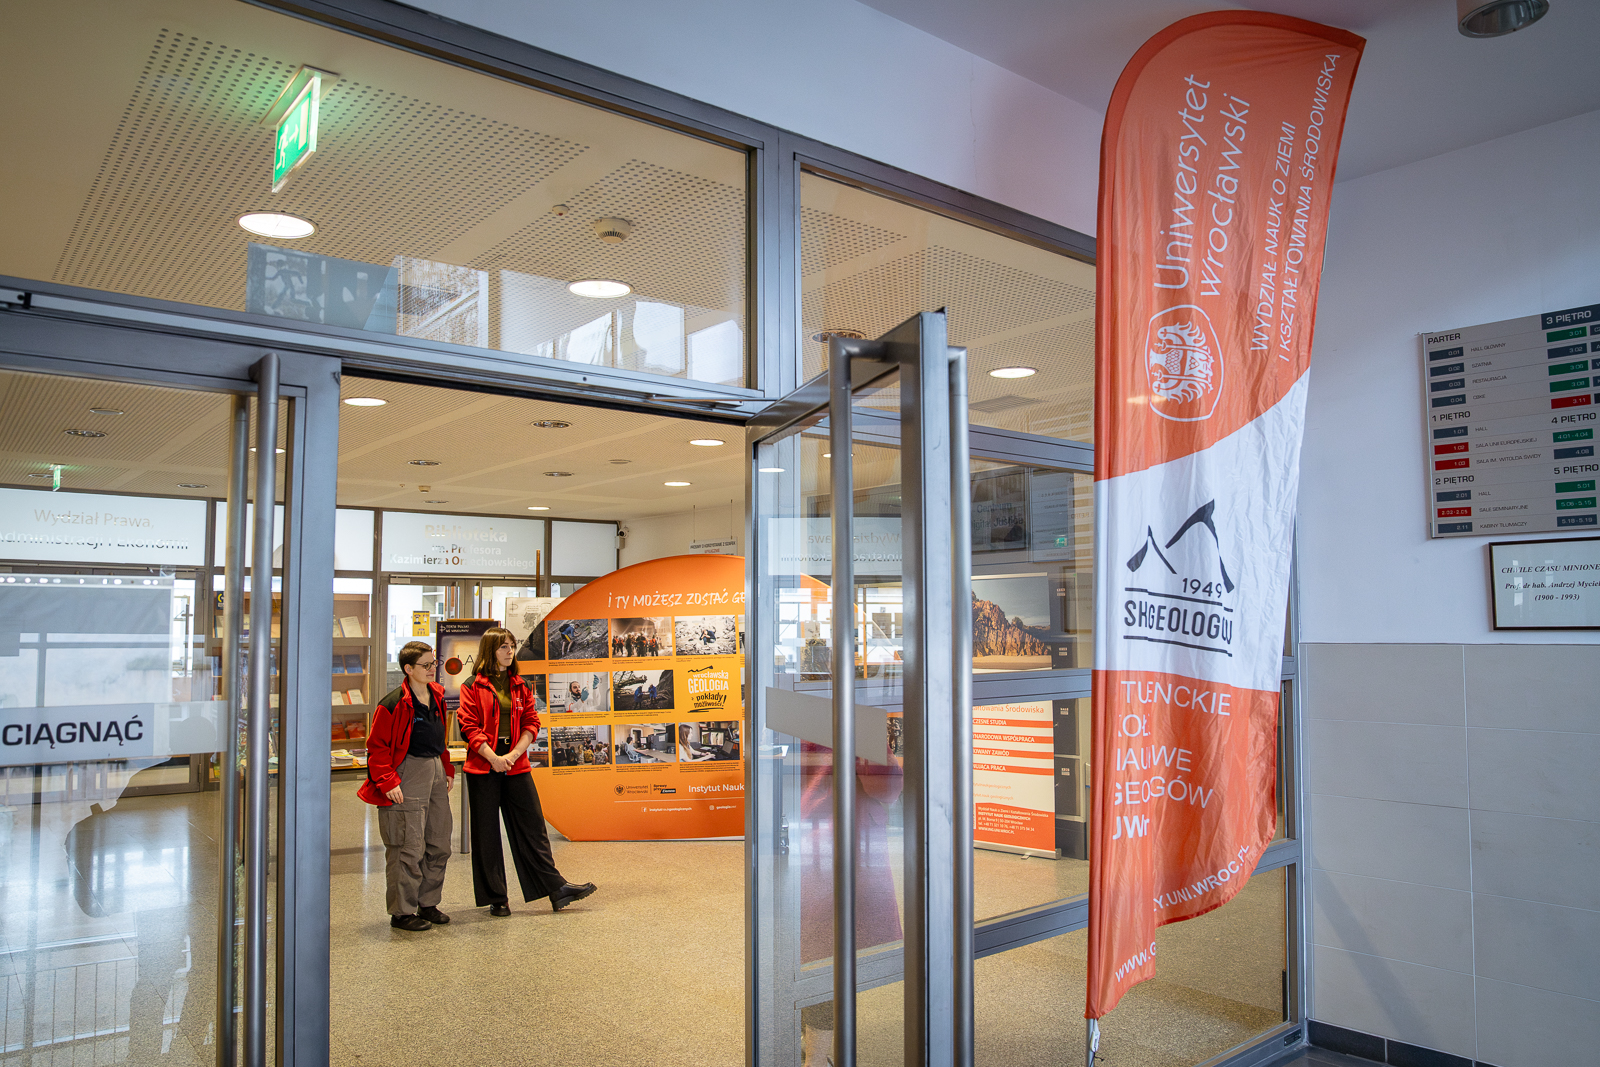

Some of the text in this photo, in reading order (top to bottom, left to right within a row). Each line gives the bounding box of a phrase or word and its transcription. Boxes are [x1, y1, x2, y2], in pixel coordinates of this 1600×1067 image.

[1154, 74, 1211, 289] Uniwersytet
[1201, 92, 1250, 296] Wrocławski
[1280, 184, 1313, 348] KSZTAŁTOWANIA
[1298, 53, 1341, 181] ŚRODOWISKA
[1250, 121, 1296, 351] WYDZIAŁ NAUK O ZIEMI
[1556, 310, 1592, 323] PIĘTRO
[1428, 332, 1461, 344] PARTER
[1440, 410, 1470, 421] PIĘTRO
[1560, 412, 1596, 424] PIĘTRO
[1563, 464, 1599, 474] PIĘTRO
[1444, 475, 1475, 485] PIĘTRO
[34, 509, 99, 526] Wydział
[425, 524, 508, 542] Biblioteka
[390, 554, 449, 566] Kazimierza
[1182, 578, 1222, 598] 1949
[615, 595, 630, 609] TY
[633, 590, 682, 607] MOŻESZ
[686, 588, 728, 606] ZOSTAĆ
[688, 678, 729, 694] GEOLOGIA
[1006, 704, 1044, 713] Środowiska
[2, 714, 143, 749] CIĄGNĄĆ
[688, 783, 744, 794] Instytut Nauk
